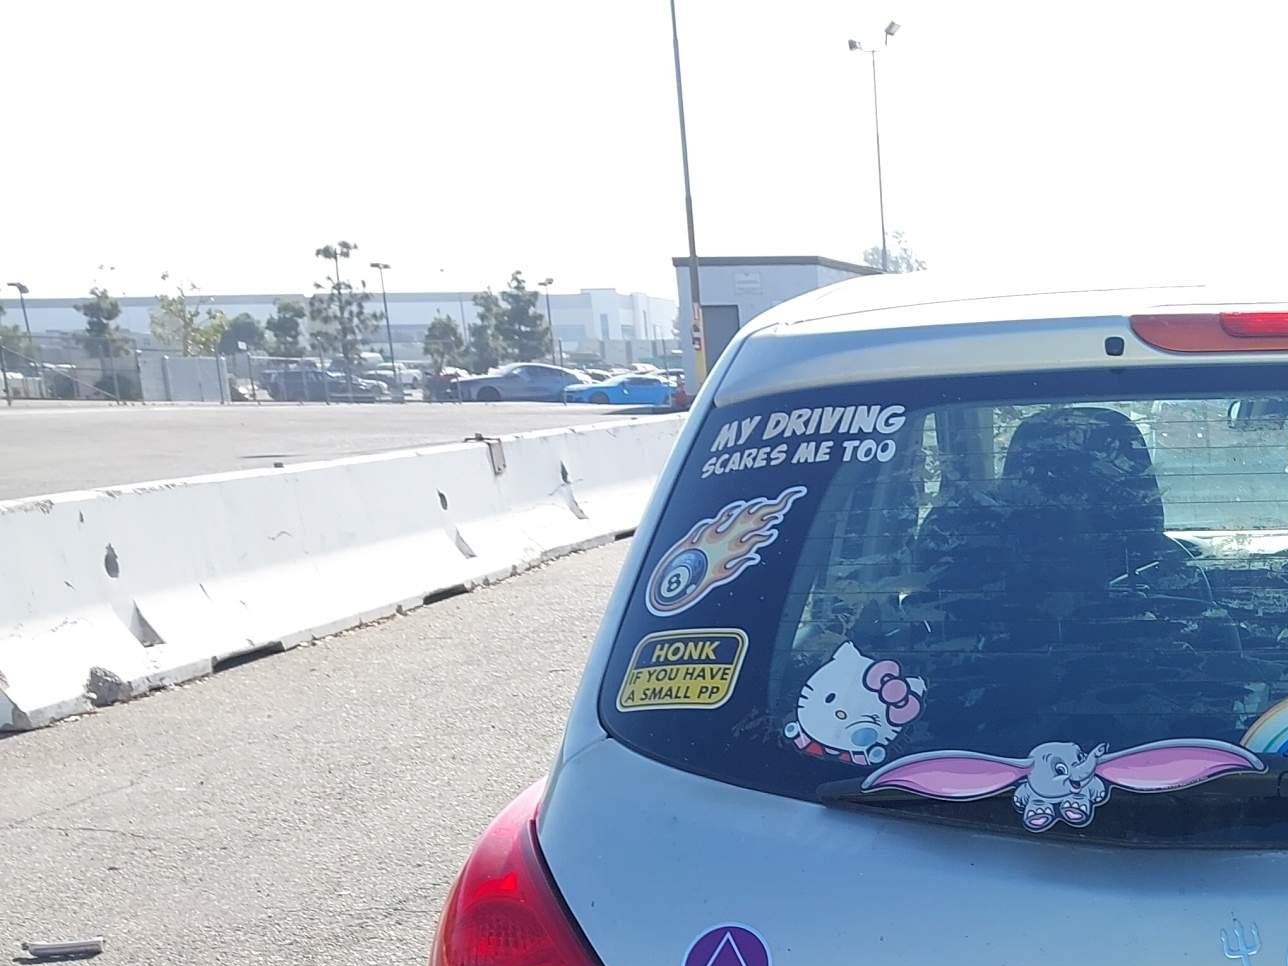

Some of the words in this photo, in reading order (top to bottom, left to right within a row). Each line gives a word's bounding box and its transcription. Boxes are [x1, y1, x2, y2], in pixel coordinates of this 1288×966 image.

[710, 415, 762, 452] MY
[762, 405, 906, 440] DRIVING
[701, 443, 788, 479] SCARES
[791, 441, 834, 464] ME
[842, 439, 896, 463] TOO
[652, 641, 720, 662] HONK
[629, 671, 641, 685] IF
[646, 668, 680, 682] YOU
[682, 667, 732, 681] HAVE
[624, 689, 636, 703] A
[640, 686, 691, 701] SMALL
[697, 685, 721, 699] PP
